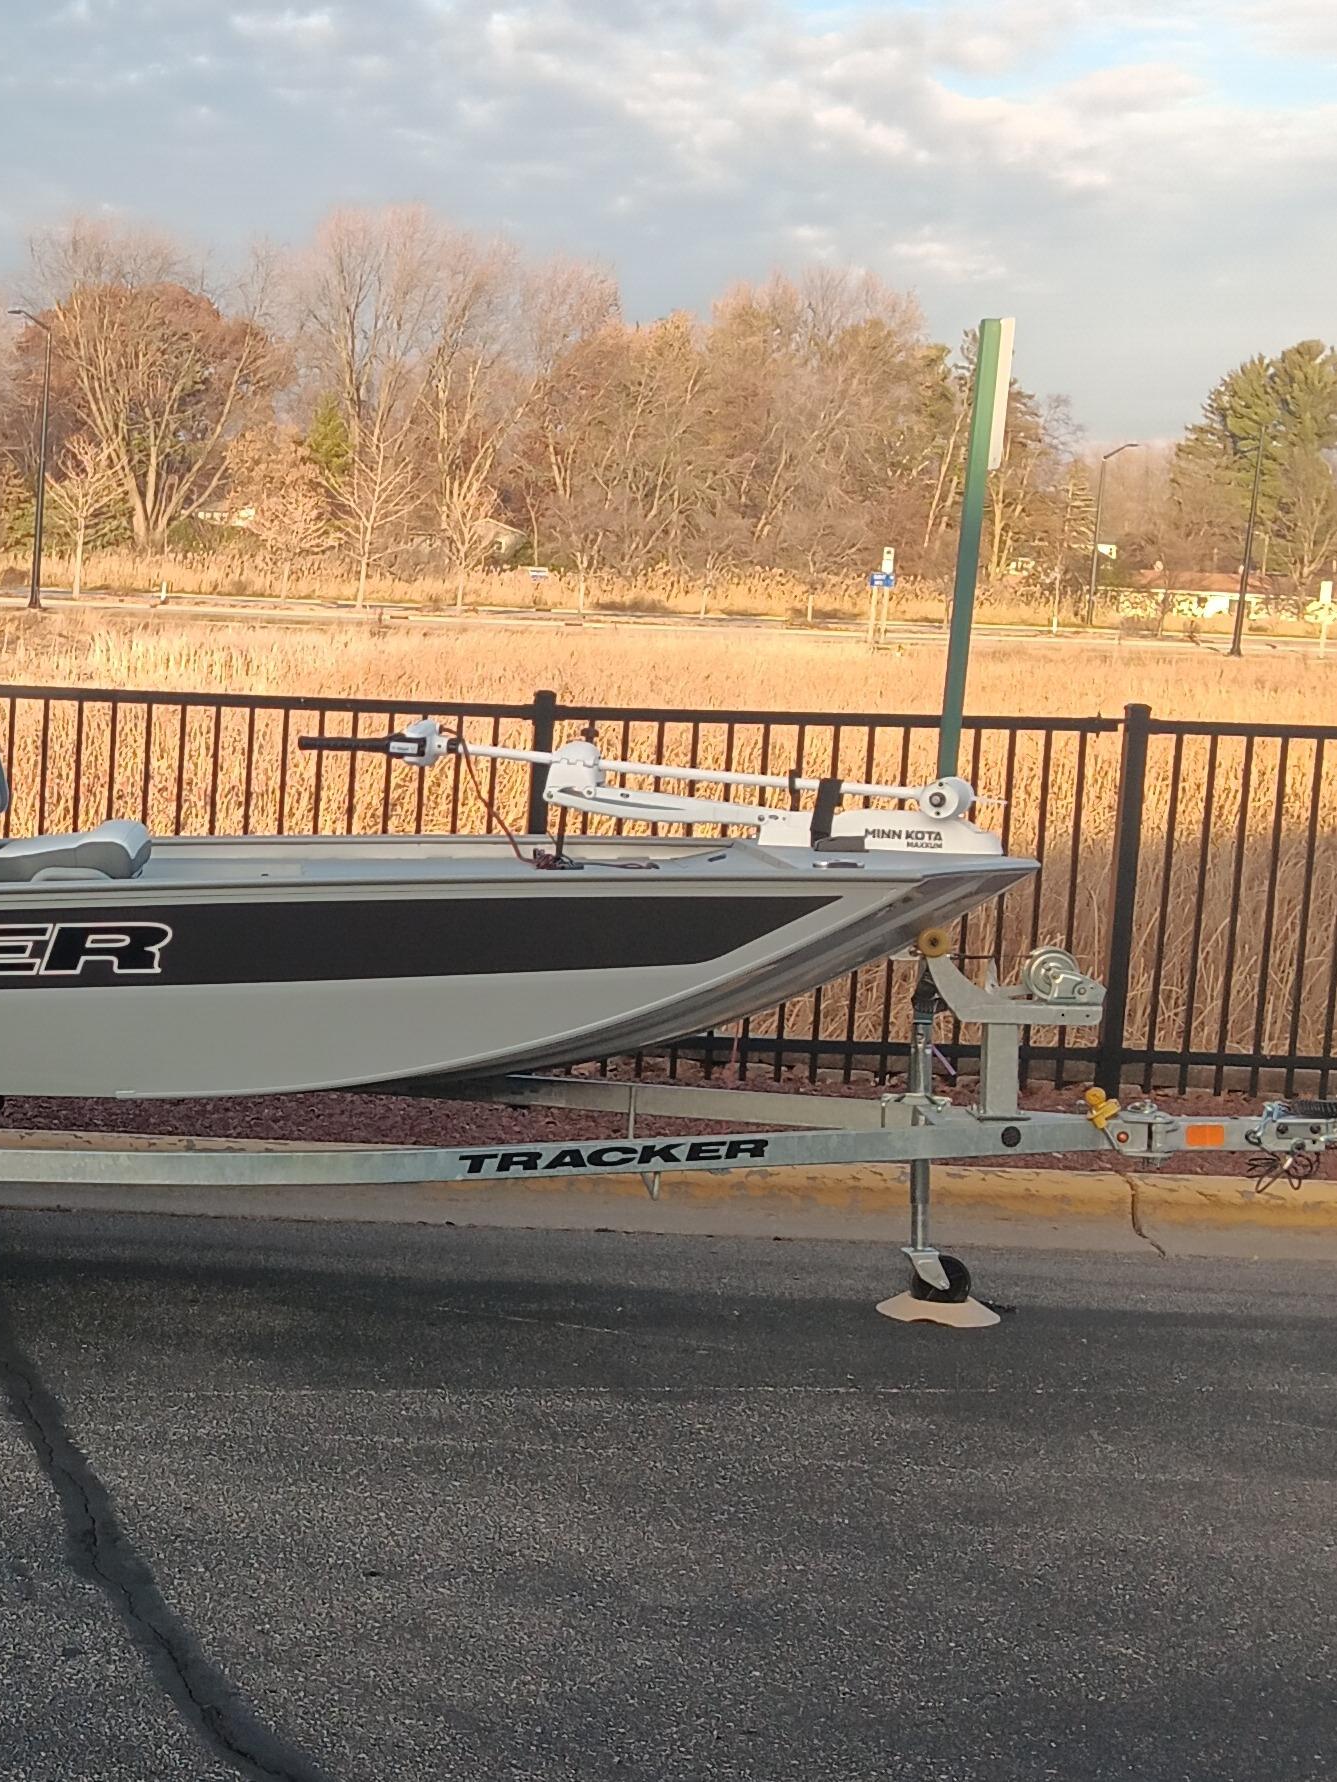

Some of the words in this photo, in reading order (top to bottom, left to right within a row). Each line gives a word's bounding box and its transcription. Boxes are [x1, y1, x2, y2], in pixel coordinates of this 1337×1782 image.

[865, 828, 902, 839] MINN
[905, 829, 943, 841] KOTA
[906, 841, 943, 849] MAXXUM
[459, 1139, 768, 1173] TRACKER
